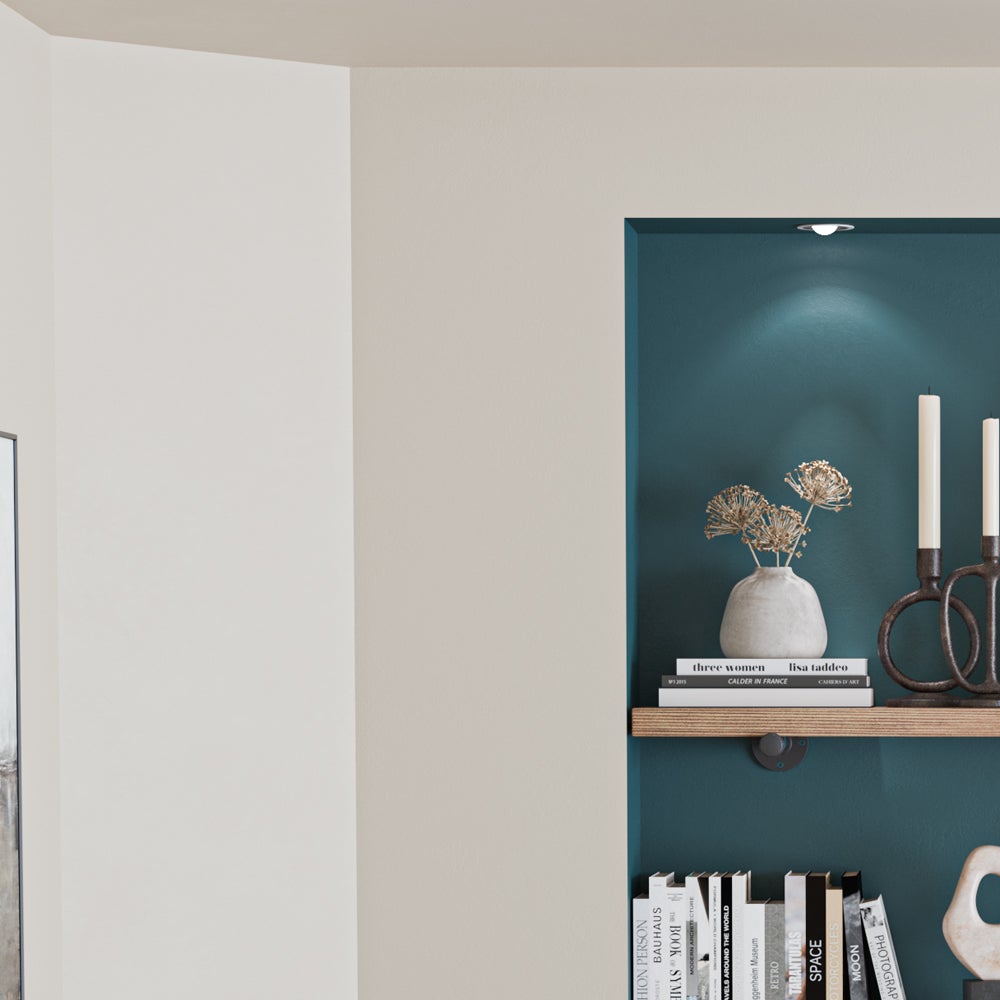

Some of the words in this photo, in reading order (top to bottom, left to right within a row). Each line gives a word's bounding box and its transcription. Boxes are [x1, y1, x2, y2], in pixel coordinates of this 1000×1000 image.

[693, 662, 723, 672] three
[725, 664, 765, 672] women
[789, 662, 808, 672] lisa
[811, 662, 849, 672] taddeo
[636, 920, 648, 965] PERSON
[652, 907, 662, 963] BAUHAUS
[669, 925, 682, 957] BOOK
[750, 938, 759, 966] Museum
[770, 961, 780, 990] RETRO
[789, 931, 802, 995] TARANTULAS
[809, 939, 822, 982] SPACE
[850, 944, 862, 982] MOON
